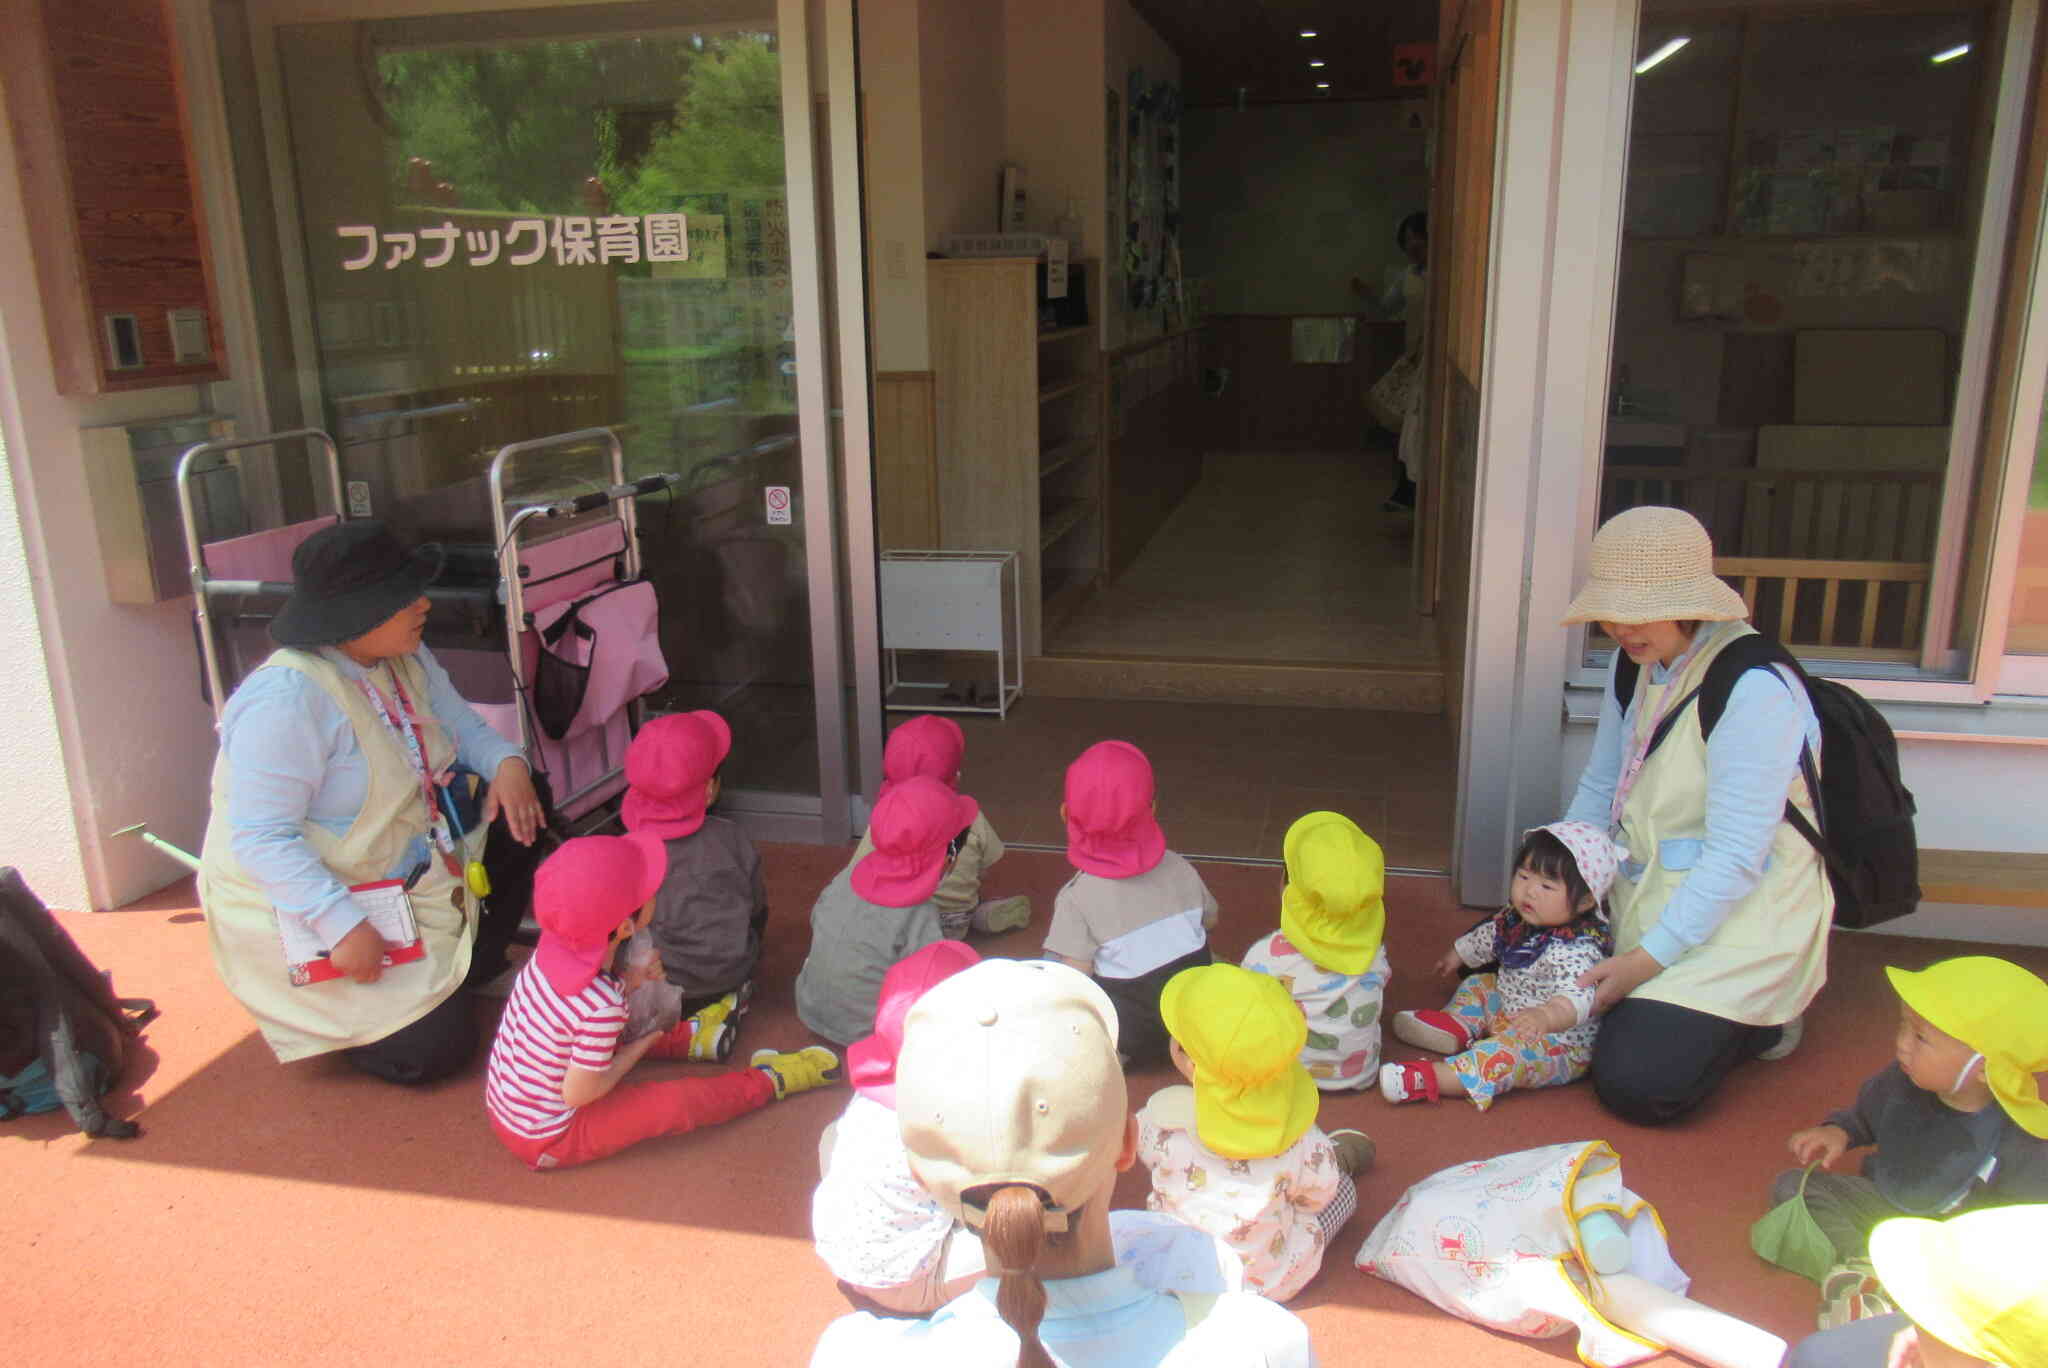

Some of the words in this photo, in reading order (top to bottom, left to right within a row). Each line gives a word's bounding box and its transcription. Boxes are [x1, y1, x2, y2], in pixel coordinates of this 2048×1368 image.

[337, 213, 689, 271] ファナック保育園
